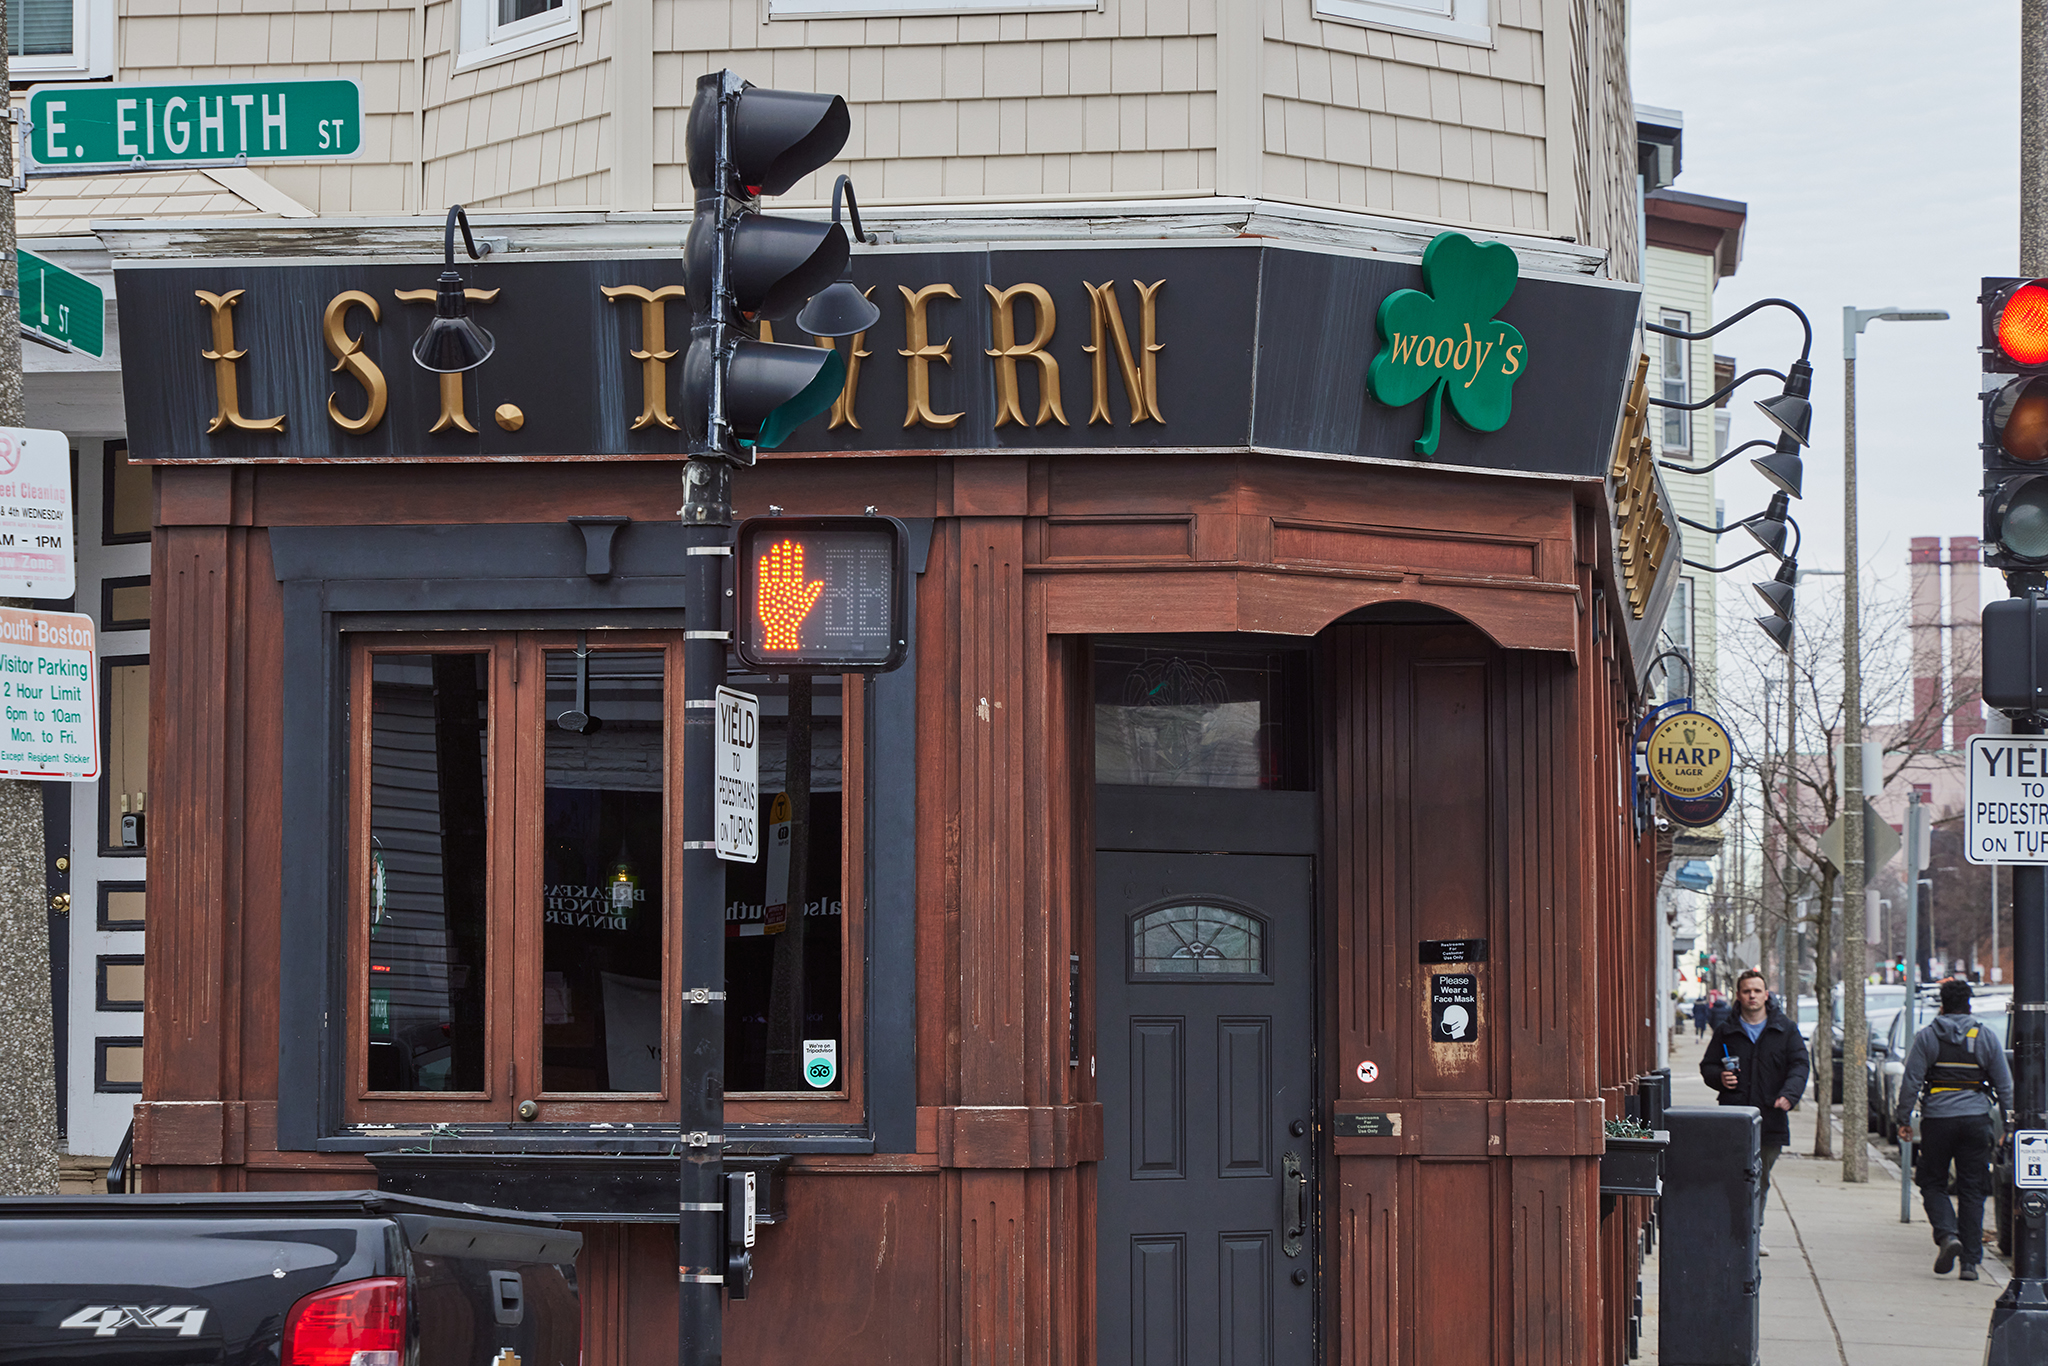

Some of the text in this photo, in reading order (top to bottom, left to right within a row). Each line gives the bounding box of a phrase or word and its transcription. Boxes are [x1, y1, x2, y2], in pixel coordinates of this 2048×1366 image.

[46, 93, 344, 158] E. EIGHTH ST
[40, 268, 70, 334] L ST
[195, 288, 286, 434] L
[600, 279, 1167, 432] TVERN
[20, 482, 66, 504] Cleaning
[8, 506, 20, 517] 4th
[22, 507, 64, 520] WEDNESDAY
[35, 535, 62, 548] 1PM
[22, 555, 54, 570] Zone
[39, 620, 92, 647] Boston
[38, 657, 88, 681] Parking
[4, 682, 82, 701] 2 Hour Limit
[6, 706, 81, 723] 6pm to 10am
[720, 702, 755, 749] YIELD
[1660, 720, 1719, 738] IMPORTED
[11, 728, 77, 744] Mon. to Fri.
[1, 750, 91, 764] Except Resident Sticker
[732, 752, 741, 773] TO
[1658, 747, 1721, 767] HARP
[1675, 768, 1703, 776] LAGER
[719, 775, 755, 811] PEDESTRIANS
[2021, 783, 2045, 798] TO
[1977, 802, 2048, 825] PEDESTR
[720, 814, 754, 847] ON TURNS
[1982, 838, 2007, 852] ON
[1440, 976, 1469, 985] Please
[1434, 995, 1475, 1003] Face Mask
[1440, 986, 1461, 994] Wear
